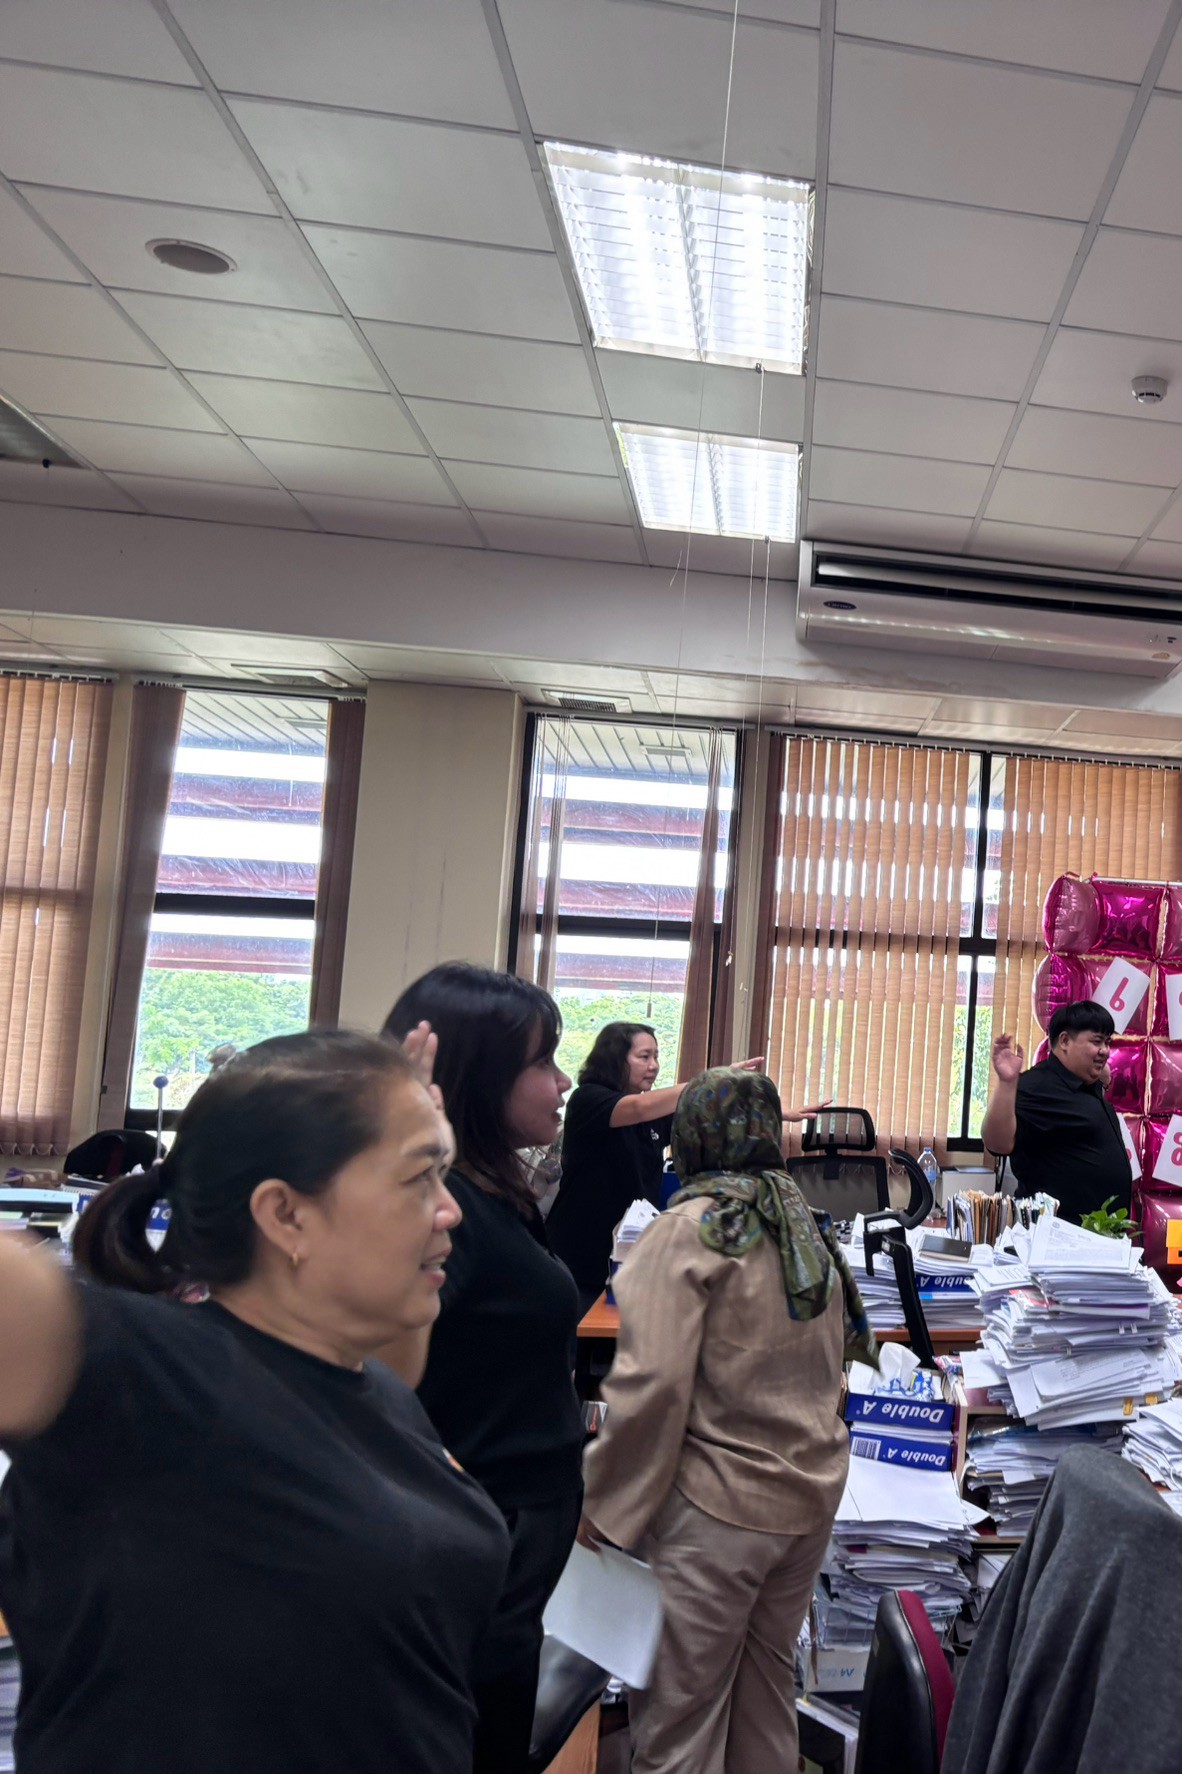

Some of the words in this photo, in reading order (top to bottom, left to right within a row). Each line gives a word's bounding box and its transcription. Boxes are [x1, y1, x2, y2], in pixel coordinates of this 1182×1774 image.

[934, 1276, 972, 1288] ouble
[863, 1400, 877, 1415] A
[881, 1402, 945, 1423] Double
[887, 1447, 898, 1459] A
[901, 1449, 946, 1466] Double
